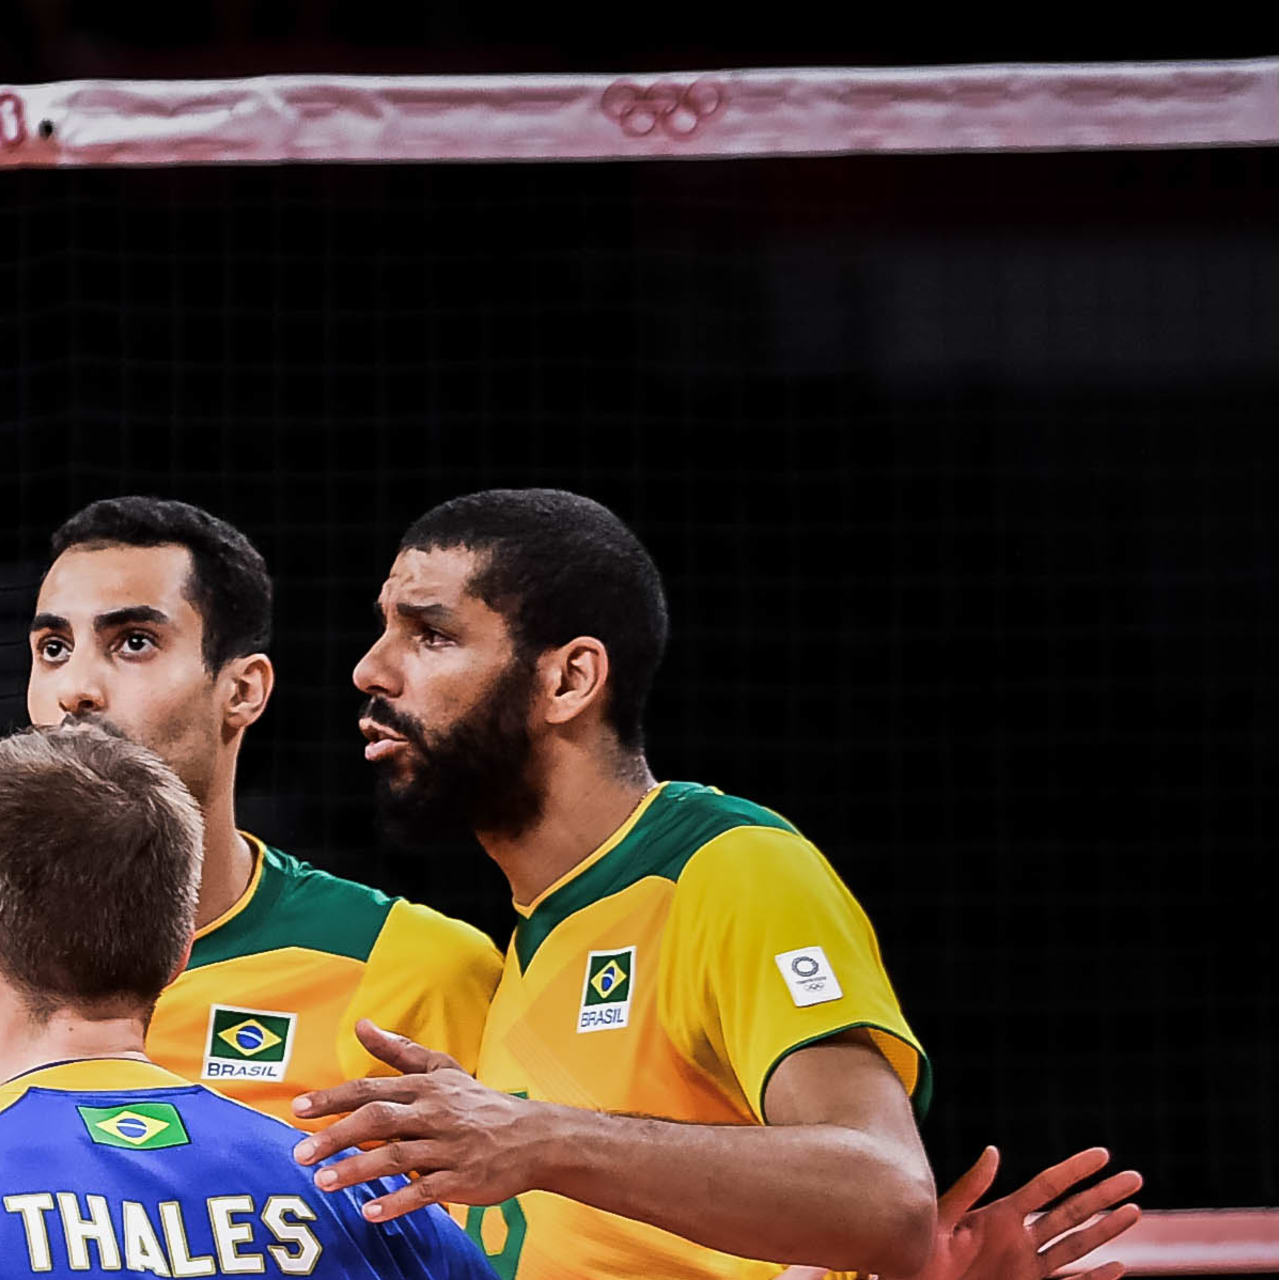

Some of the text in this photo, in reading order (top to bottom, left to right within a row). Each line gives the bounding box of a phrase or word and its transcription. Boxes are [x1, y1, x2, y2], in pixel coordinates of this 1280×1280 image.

[581, 1007, 624, 1027] BRASIL
[207, 1062, 278, 1077] BRASIL
[3, 1191, 324, 1278] THALES
